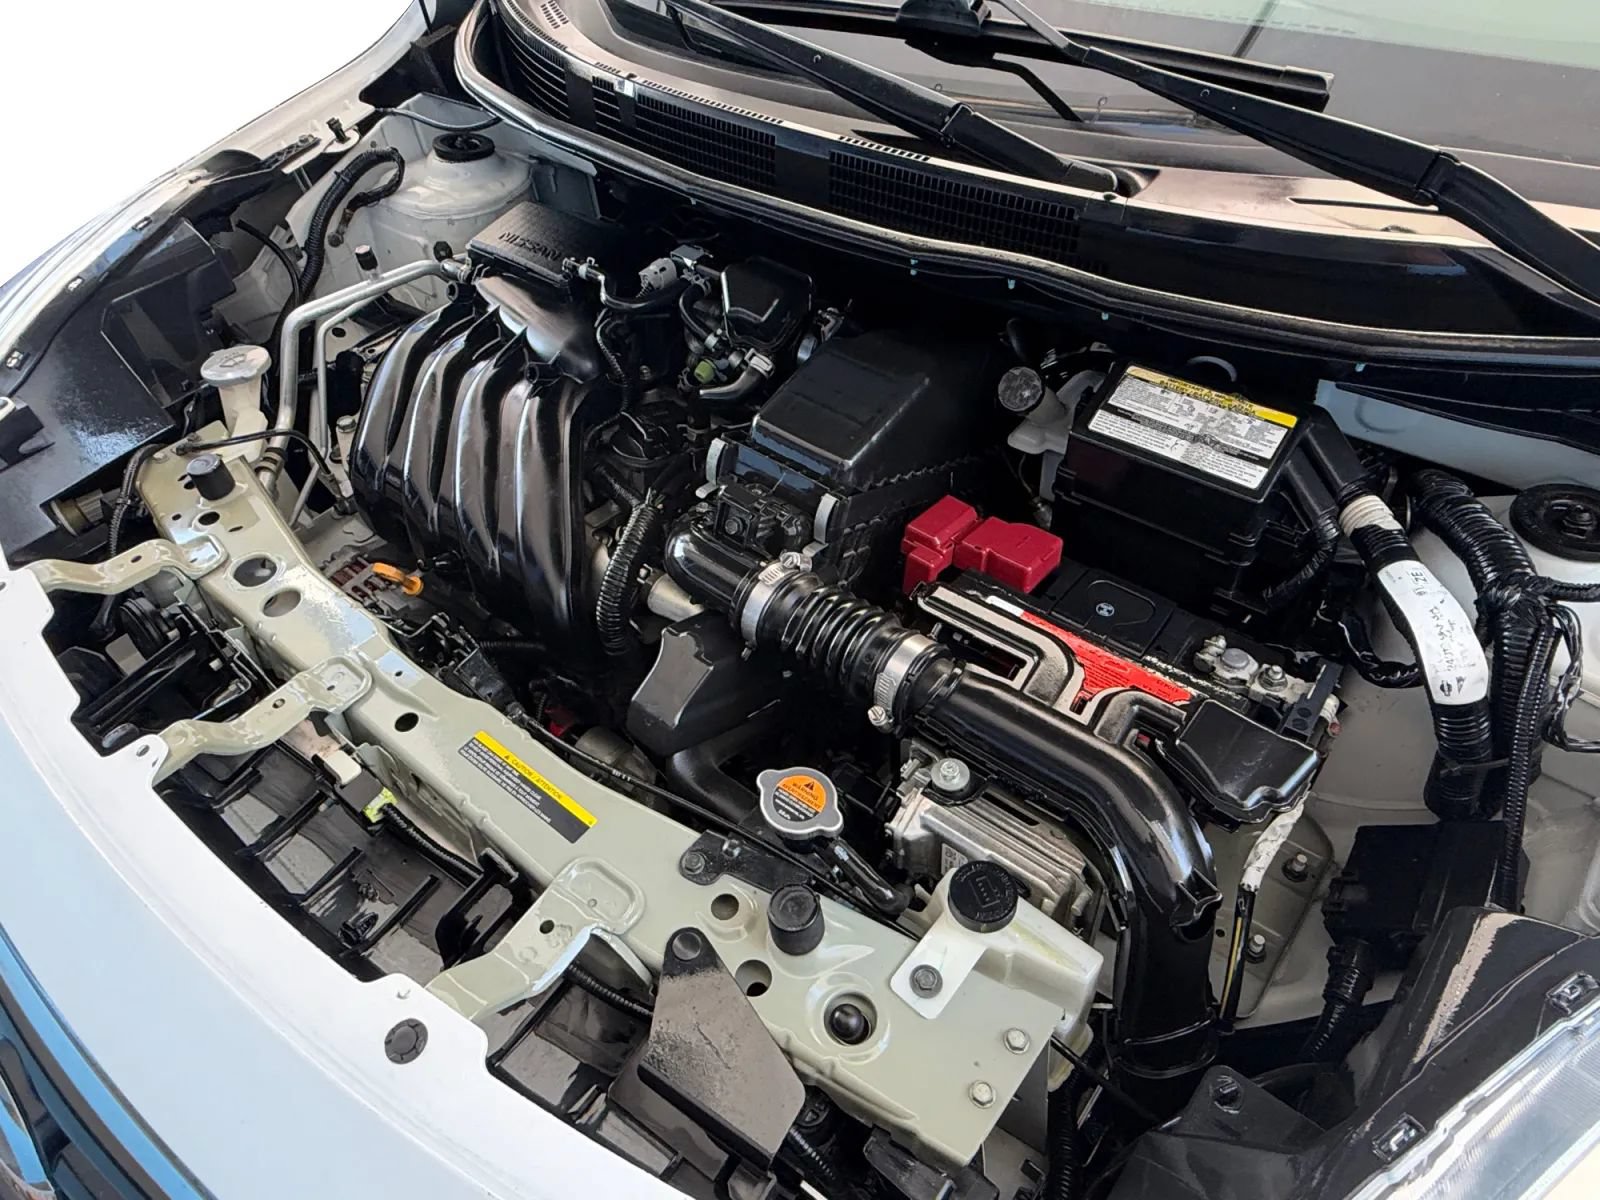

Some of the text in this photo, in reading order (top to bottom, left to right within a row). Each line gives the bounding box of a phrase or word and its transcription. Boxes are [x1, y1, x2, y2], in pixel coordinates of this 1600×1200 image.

[499, 231, 562, 260] NISSAN
[512, 759, 533, 776] CAUTION
[536, 778, 561, 798] ATTENTION
[792, 782, 819, 800] WARNING
